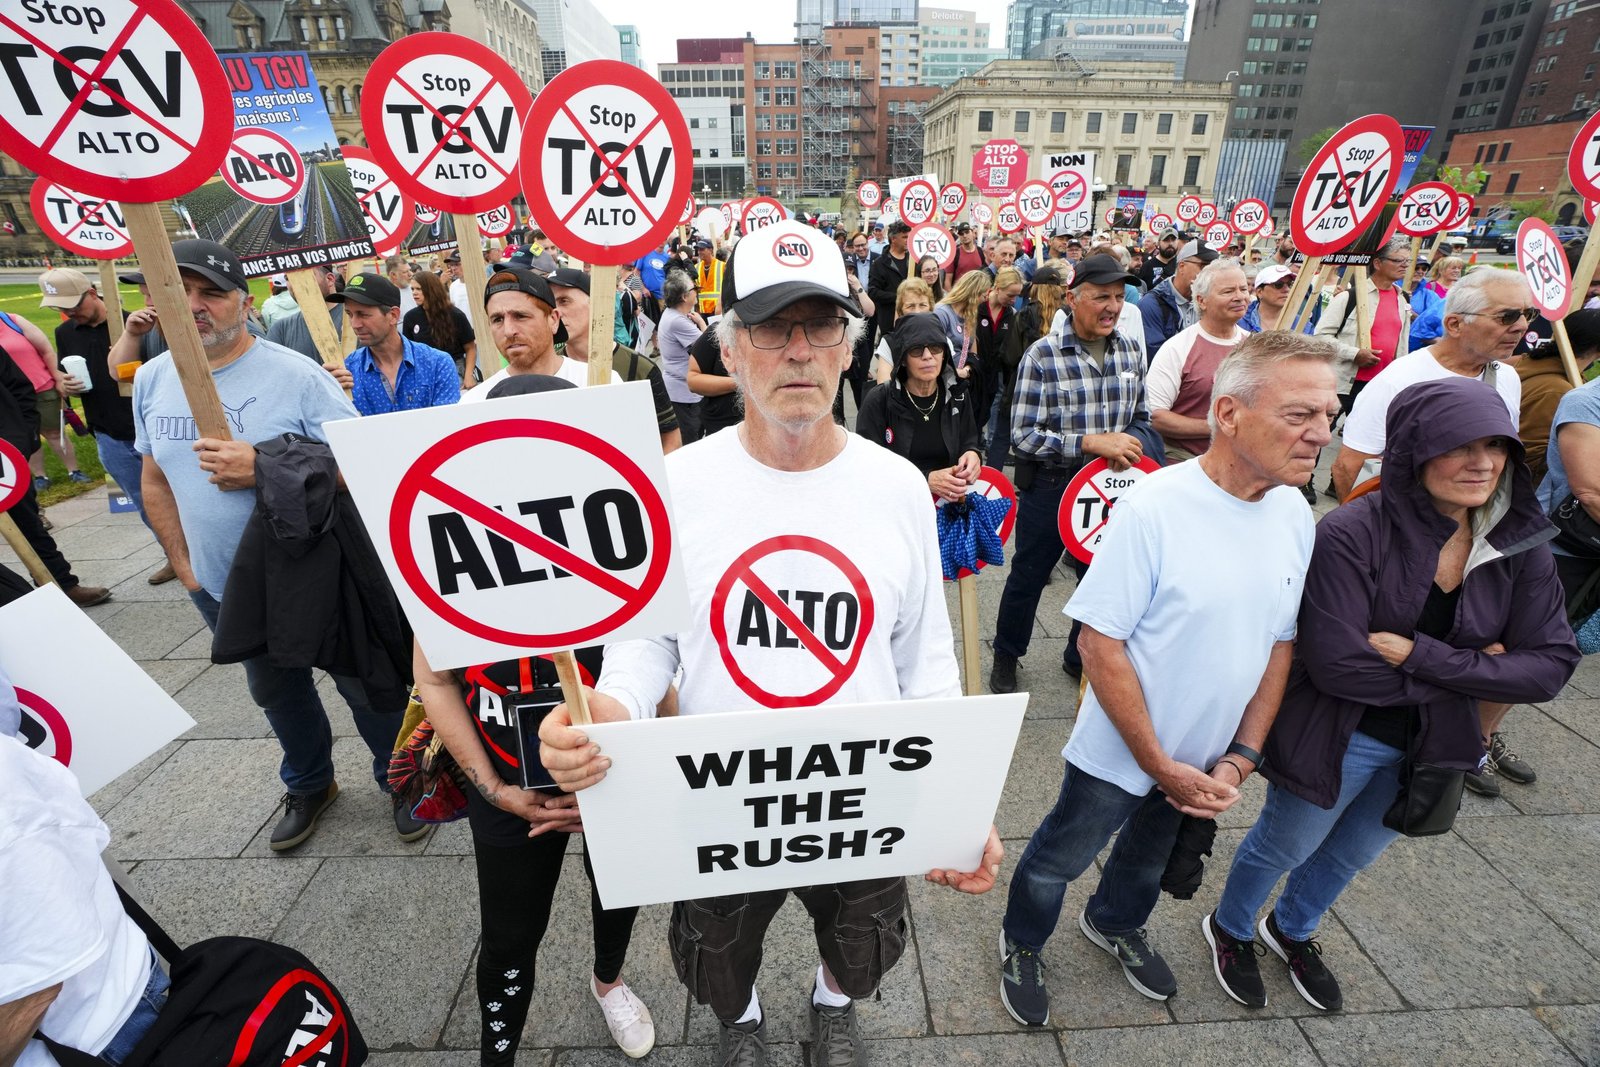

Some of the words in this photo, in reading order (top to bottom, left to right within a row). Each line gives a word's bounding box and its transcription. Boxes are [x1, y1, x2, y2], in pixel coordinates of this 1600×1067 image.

[21, 0, 106, 34] Stop
[931, 11, 963, 20] Deloitte
[0, 42, 181, 118] TGV
[250, 55, 310, 90] TGV
[422, 73, 471, 97] Stop
[254, 90, 314, 109] agricoles
[235, 110, 293, 126] maisons
[292, 107, 300, 121] !
[589, 105, 636, 133] Stop
[385, 104, 514, 154] TGV
[78, 131, 160, 154] ALTO
[984, 144, 1018, 155] STOP
[983, 155, 1018, 165] ALTO
[1051, 154, 1085, 168] NON
[1346, 147, 1375, 164] Stop
[230, 152, 297, 183] ALTO
[435, 163, 487, 180] ALTO
[548, 137, 672, 198] TGV
[862, 191, 878, 199] TGV
[1311, 169, 1389, 210] TGV
[906, 197, 932, 212] TGV
[943, 194, 963, 204] TGV
[1021, 195, 1050, 211] TGV
[477, 207, 507, 226] TGV
[584, 208, 636, 226] ALTO
[1000, 213, 1020, 223] TGV
[1181, 205, 1199, 213] TGV
[1236, 211, 1262, 223] TGV
[1403, 201, 1450, 219] TGV
[747, 215, 780, 232] TGV
[1064, 211, 1088, 229] C-15
[1316, 216, 1348, 230] ALTO
[79, 230, 115, 241] ALTO
[1209, 232, 1229, 240] TGV
[778, 243, 809, 257] ALTO
[915, 240, 948, 253] TGV
[1529, 239, 1542, 253] Stop
[278, 253, 302, 271] PAR
[302, 248, 328, 267] VOS
[329, 241, 372, 261] IMPÔTS
[1335, 254, 1348, 263] VOS
[1526, 247, 1561, 291] TGV
[1545, 284, 1561, 301] ALTO
[156, 416, 199, 440] PUM
[428, 488, 648, 596] ALTO
[737, 589, 859, 651] ALTO
[675, 736, 934, 790] WHAT'S
[743, 787, 867, 828] THE
[697, 826, 905, 874] RUSH?
